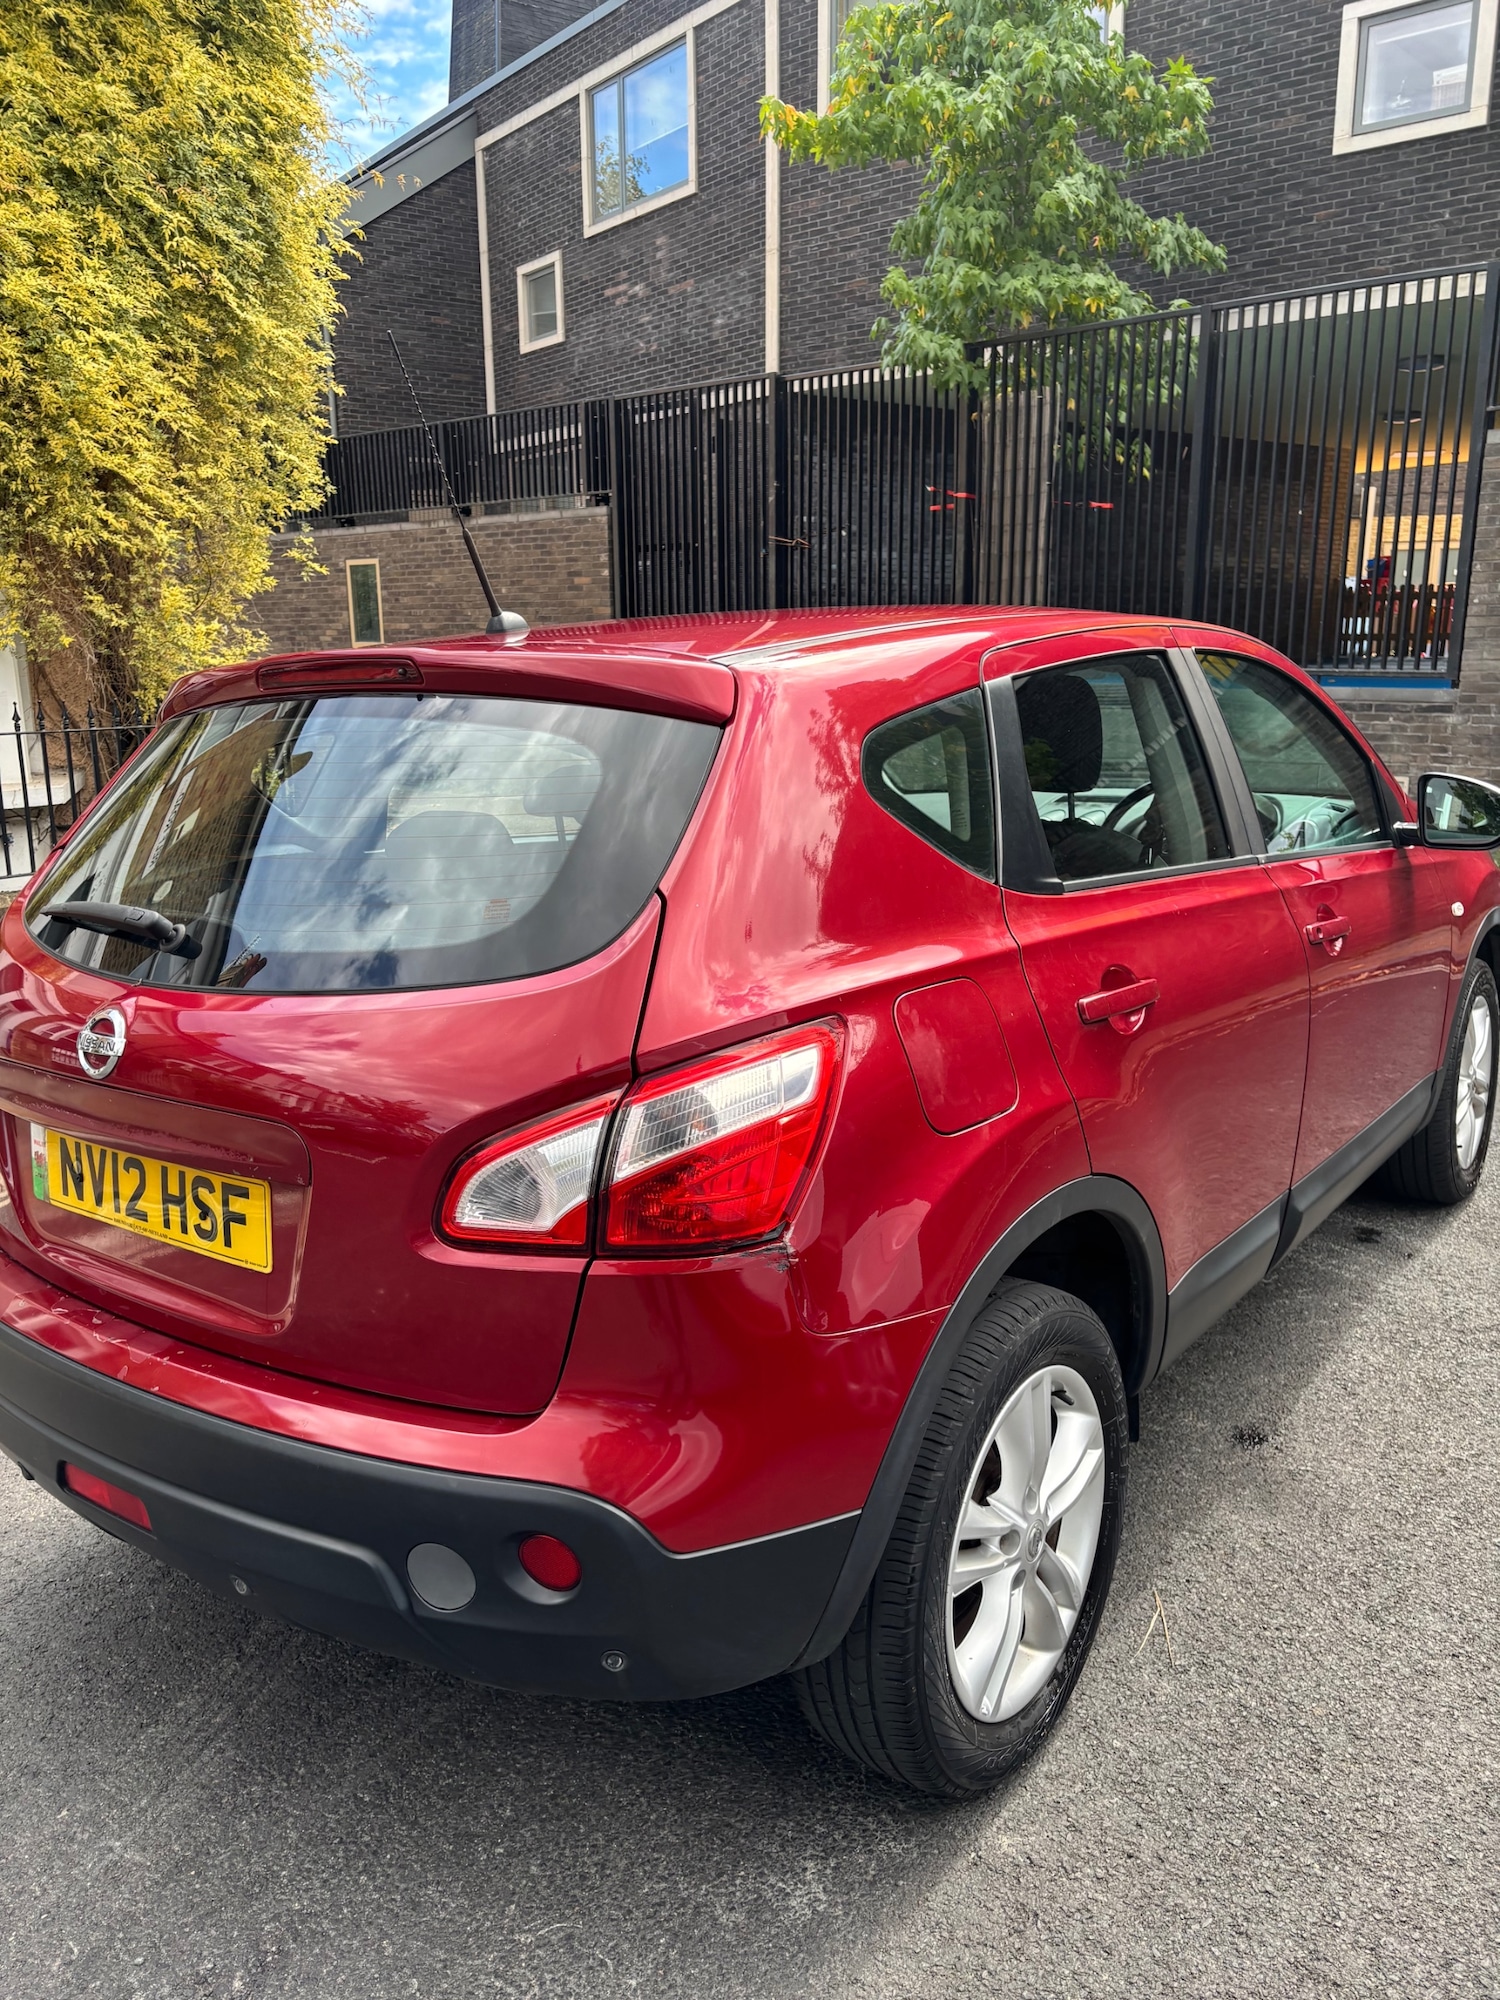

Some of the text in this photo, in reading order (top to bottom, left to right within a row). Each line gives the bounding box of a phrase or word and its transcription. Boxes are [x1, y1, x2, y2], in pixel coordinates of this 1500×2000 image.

[80, 1032, 115, 1052] NISSAN
[59, 1137, 249, 1249] NV12 HSF
